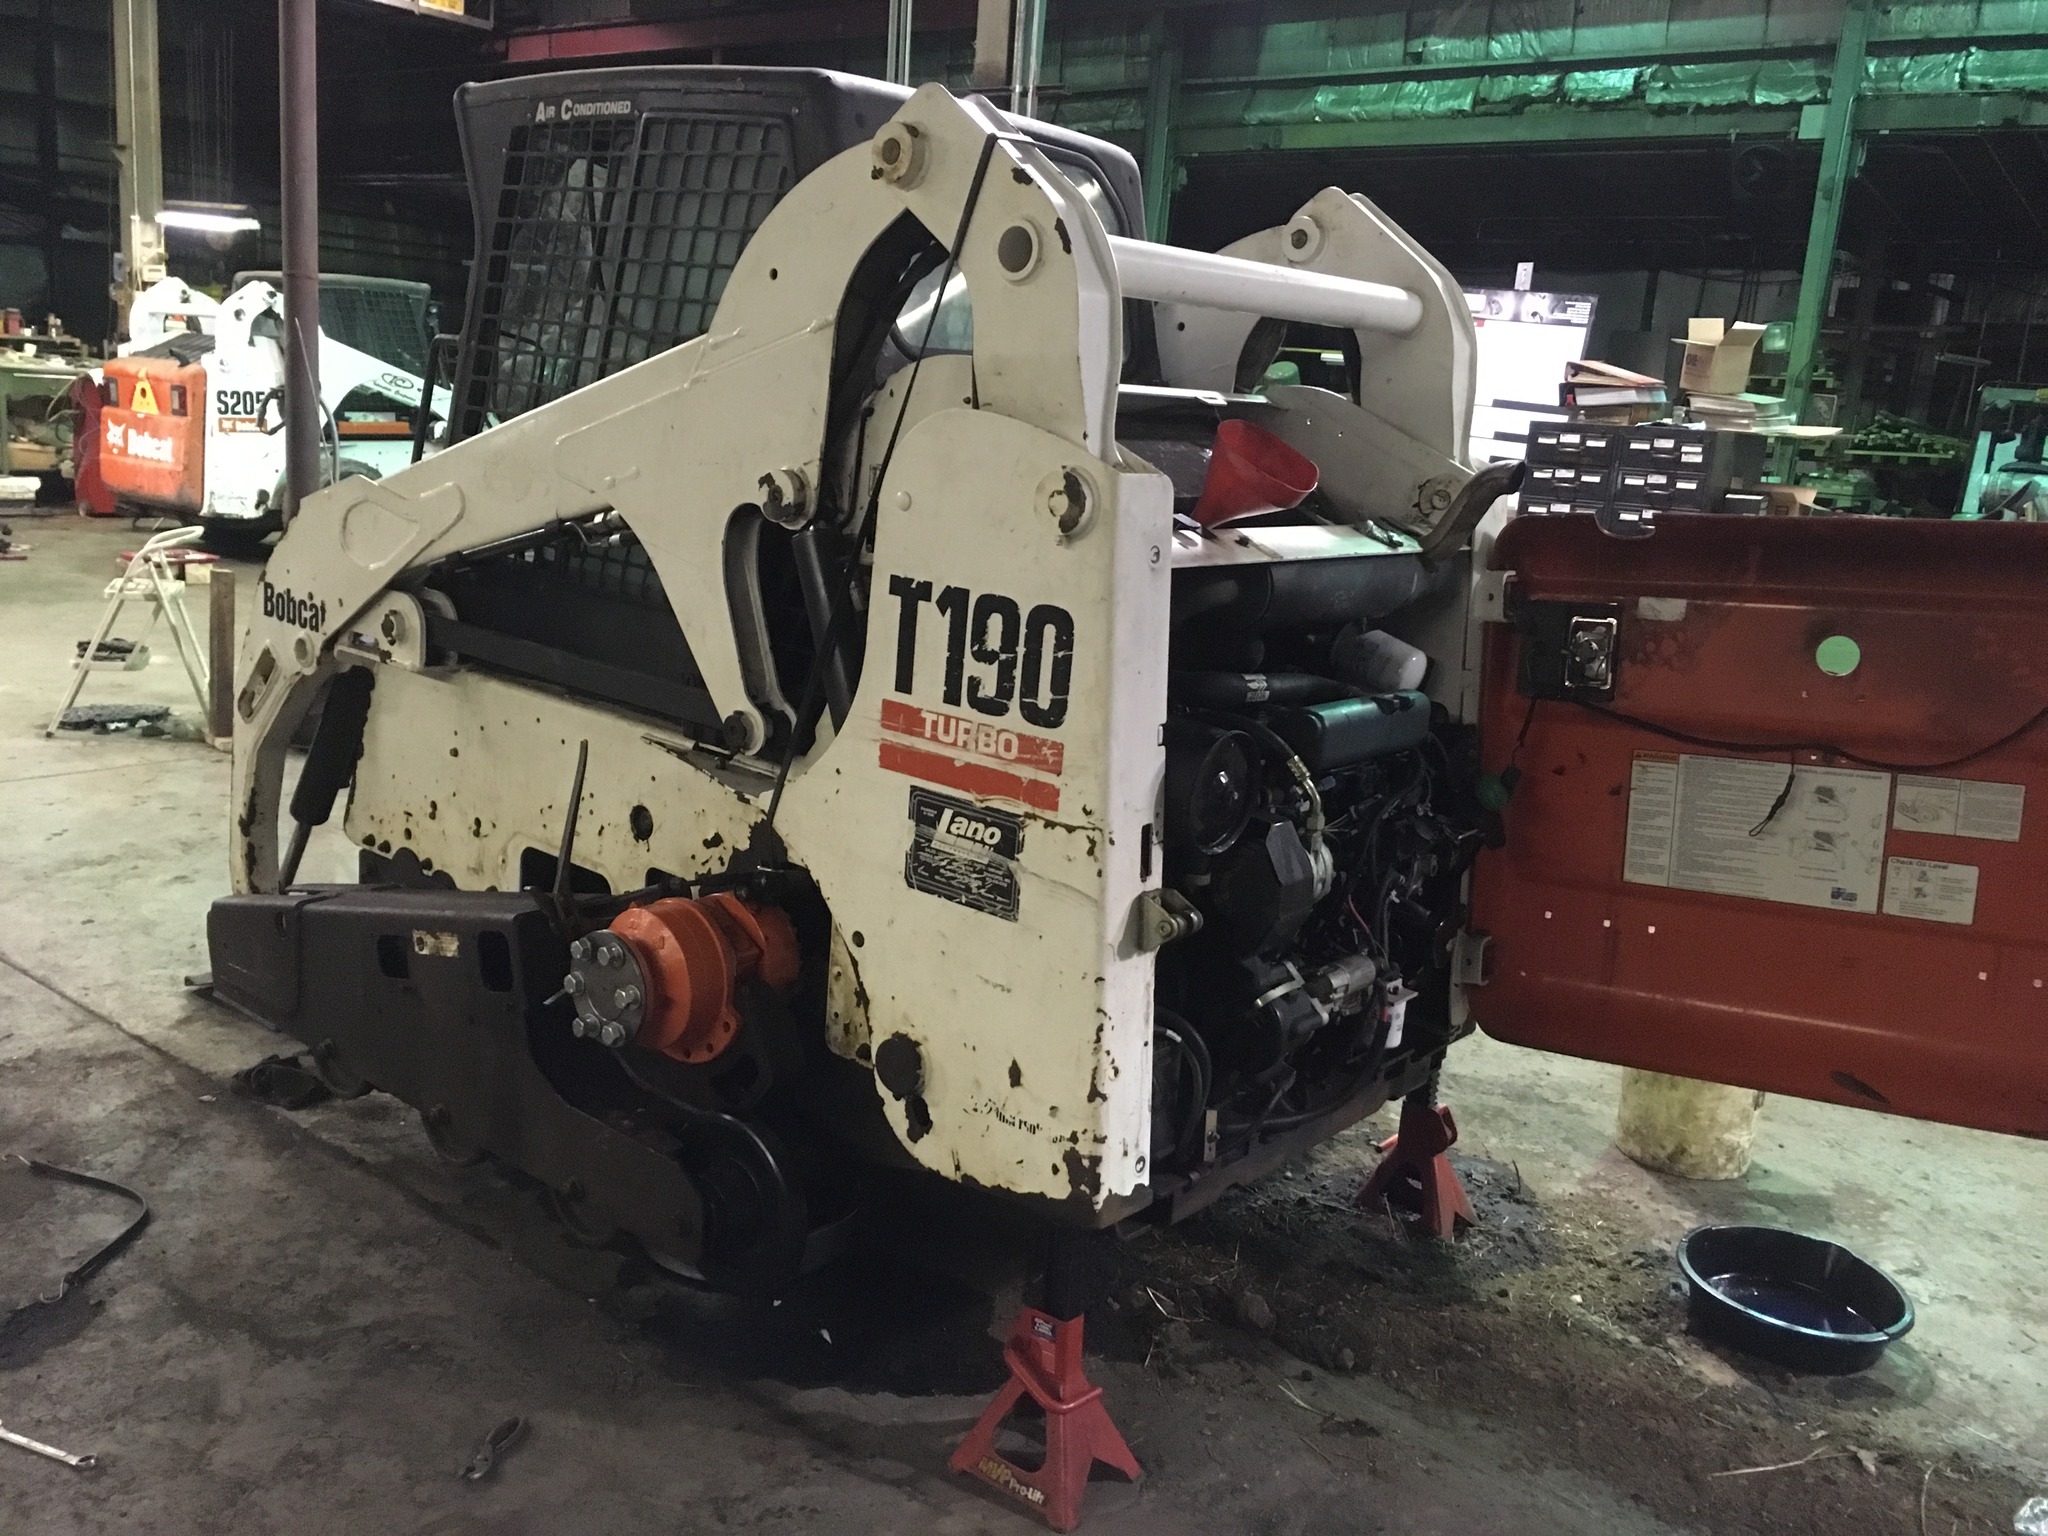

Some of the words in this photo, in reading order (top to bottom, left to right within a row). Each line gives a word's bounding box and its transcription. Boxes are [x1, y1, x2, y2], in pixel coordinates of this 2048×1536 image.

[561, 98, 631, 120] CONDITIONED
[263, 581, 327, 633] Bobcat
[888, 574, 1075, 729] T190
[920, 710, 1019, 760] TURBO
[935, 807, 1002, 845] Lano
